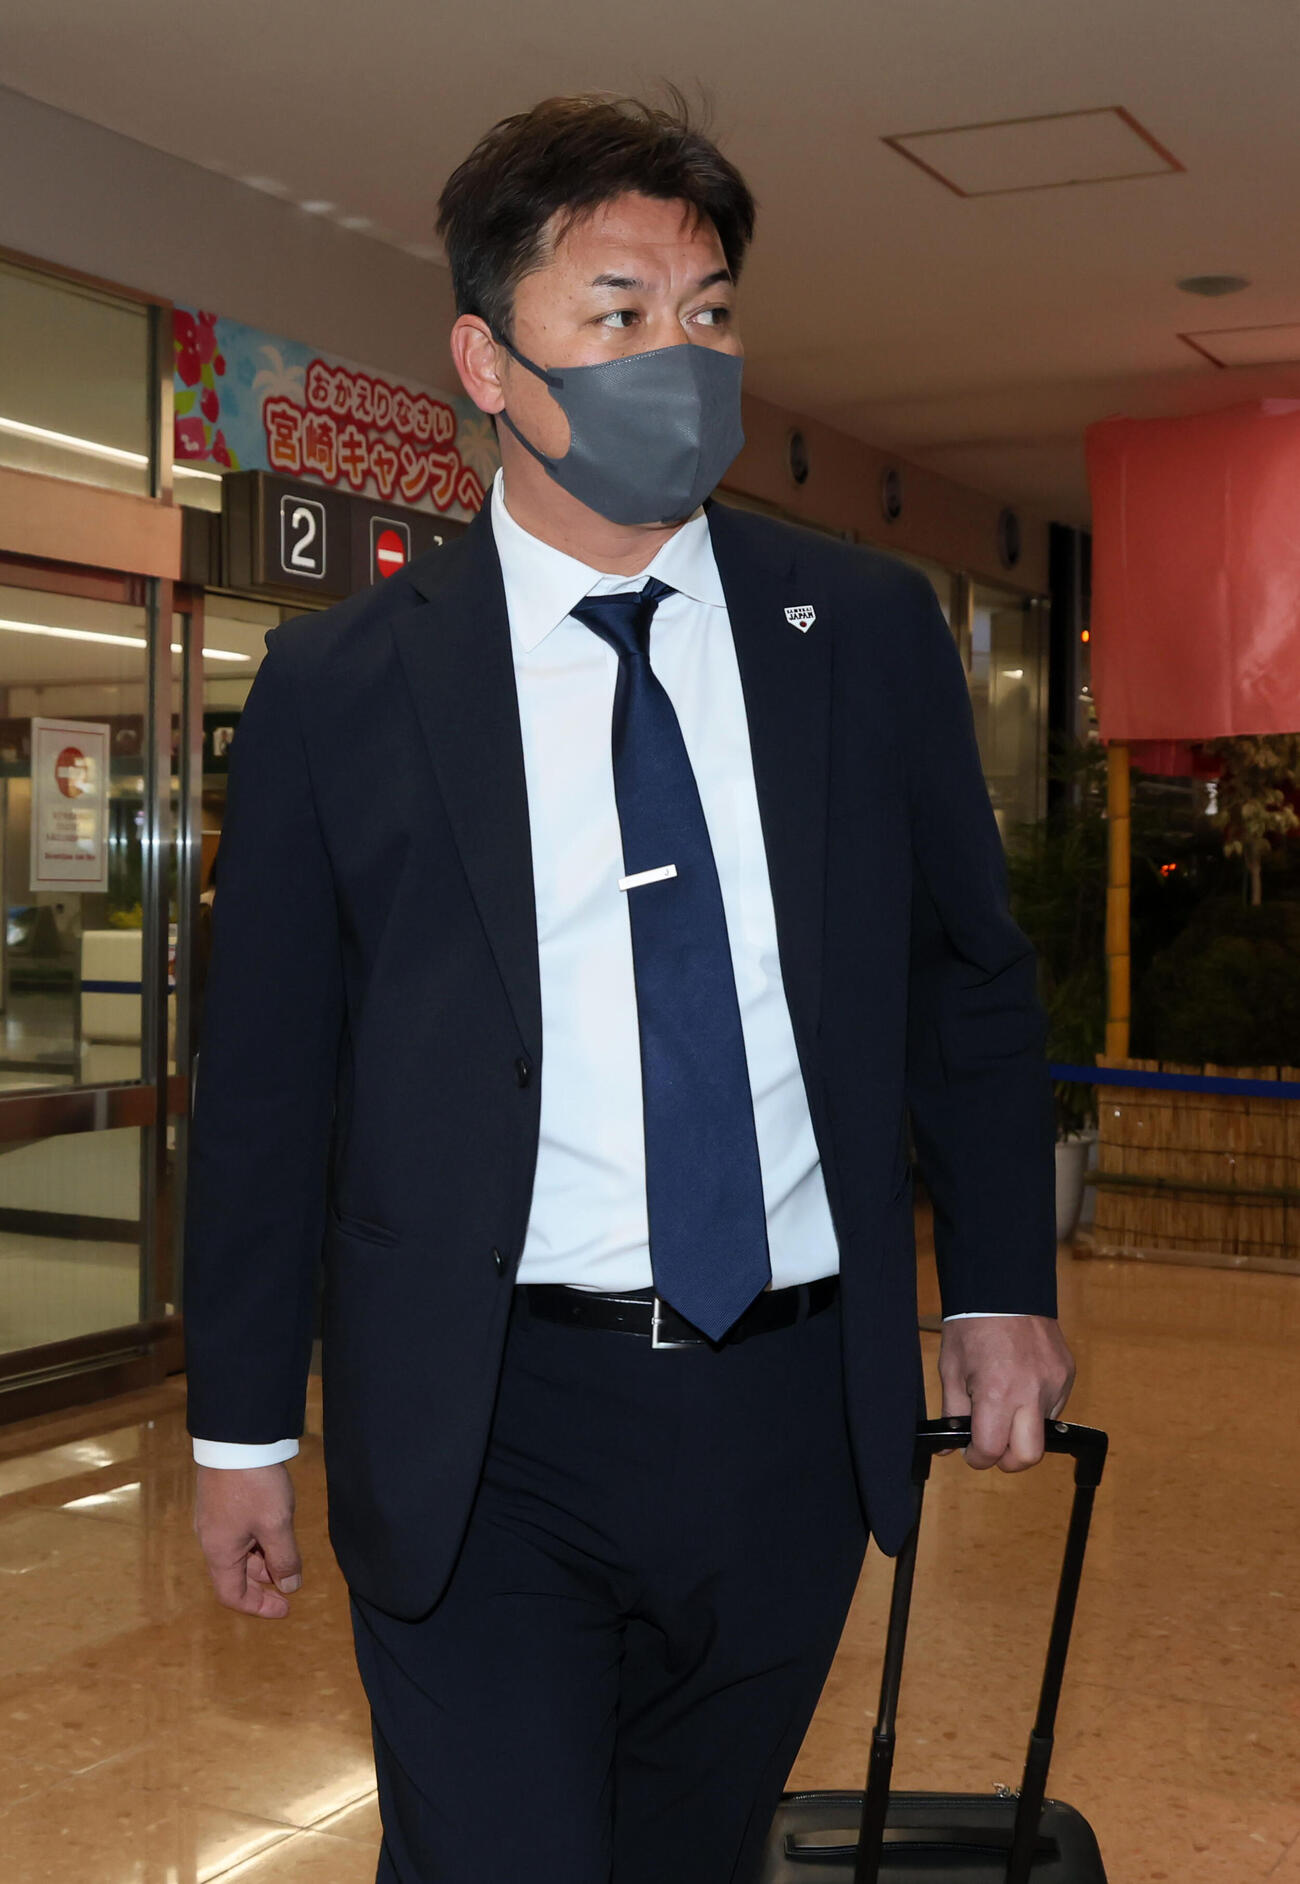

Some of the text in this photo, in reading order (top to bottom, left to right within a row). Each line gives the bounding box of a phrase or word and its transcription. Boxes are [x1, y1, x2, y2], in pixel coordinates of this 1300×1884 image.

[308, 362, 455, 443] おかえりなさい
[267, 403, 484, 511] 宮崎キャンプへ
[291, 506, 316, 568] 2
[789, 611, 813, 621] JAPAN
